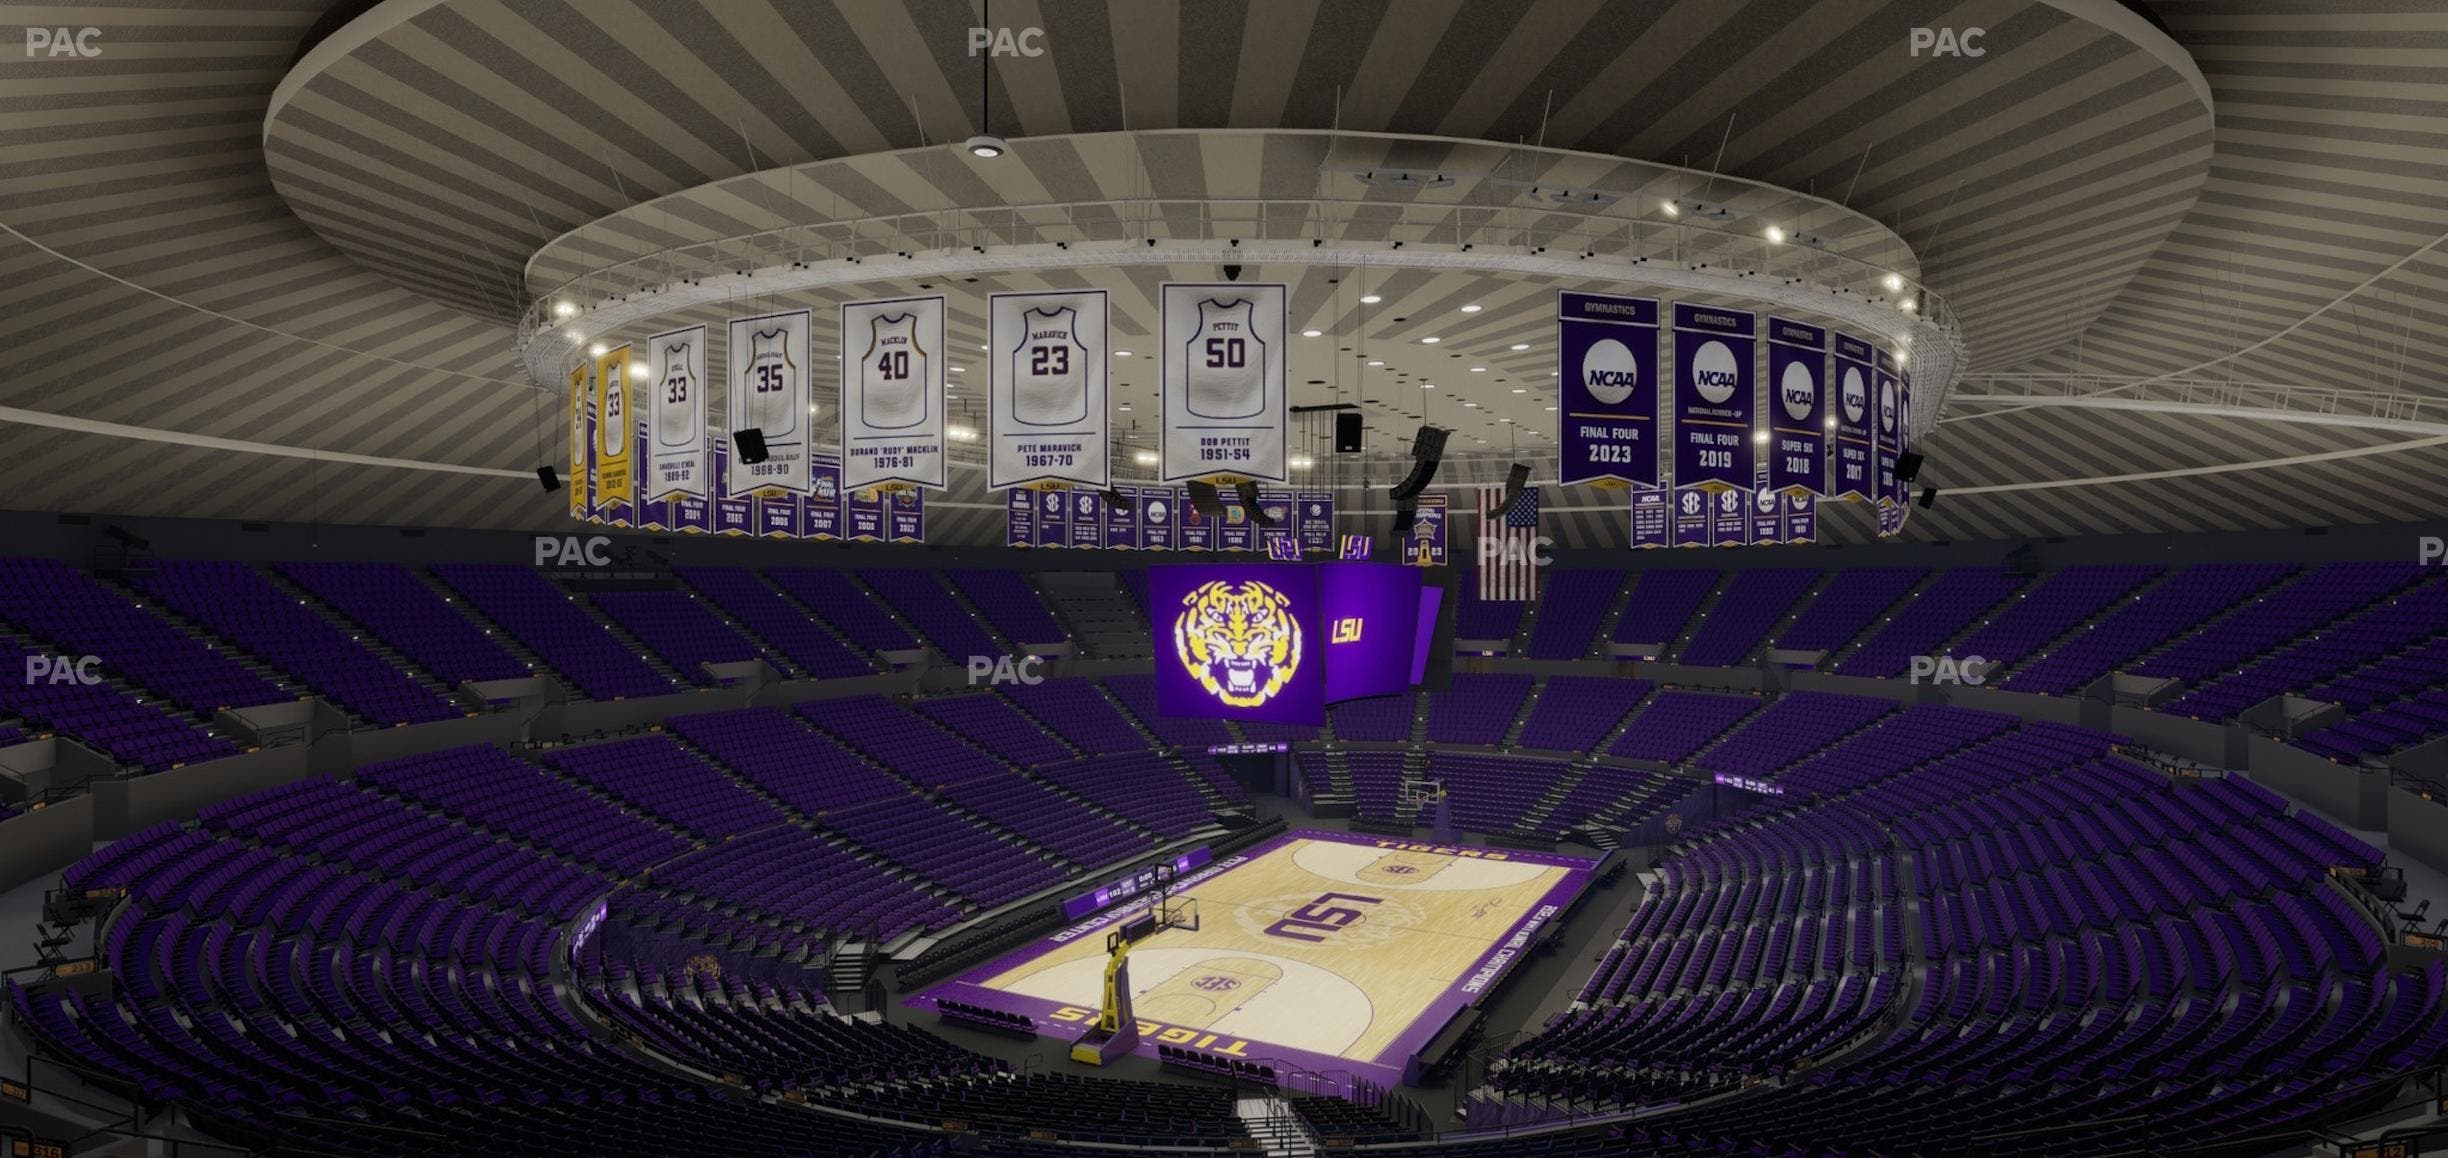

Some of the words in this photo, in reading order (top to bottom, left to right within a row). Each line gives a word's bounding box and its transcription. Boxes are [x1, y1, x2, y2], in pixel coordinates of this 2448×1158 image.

[1585, 302, 1635, 316] GYMNASTICS
[1213, 323, 1239, 332] PETTIT
[1694, 313, 1737, 327] GYMNASTICS
[1032, 331, 1068, 340] MARAVICH
[1032, 346, 1068, 376] 23
[1207, 338, 1245, 368] 50
[879, 351, 908, 380] 40
[757, 364, 783, 392] 35
[1589, 370, 1635, 387] NCAA
[1698, 370, 1737, 388] NCAA
[669, 376, 686, 404] 33
[1785, 389, 1812, 406] NCAA
[608, 391, 620, 418] 33
[1201, 437, 1217, 446] BOB
[1221, 437, 1250, 446] PETTIT
[1580, 426, 1608, 439] FINAL
[1612, 428, 1639, 440] FOUR
[1690, 432, 1714, 445] FINAL
[1717, 434, 1739, 447] FOUR
[850, 448, 877, 457] DURAND
[906, 445, 938, 454] MACKLIN
[1018, 445, 1036, 453] PETE
[1040, 444, 1081, 453] MARAVICH
[1201, 448, 1250, 460] 1951-54
[1589, 444, 1631, 463] 2023
[1781, 440, 1801, 452] SUPER
[1803, 443, 1813, 453] SIX
[874, 456, 913, 469] 1976-81
[1027, 455, 1073, 467] 1967-70
[1699, 450, 1732, 468] 2019
[1786, 457, 1810, 474] 2018
[751, 464, 789, 476] 1988-90
[1682, 491, 1700, 514] SEC
[1721, 489, 1738, 513] SEC
[1332, 618, 1363, 644] LSU
[1376, 840, 1509, 860] TIGERS
[1263, 892, 1385, 943] LSU
[1461, 949, 1516, 993] CHAMPIONS
[1195, 976, 1236, 991] SEC
